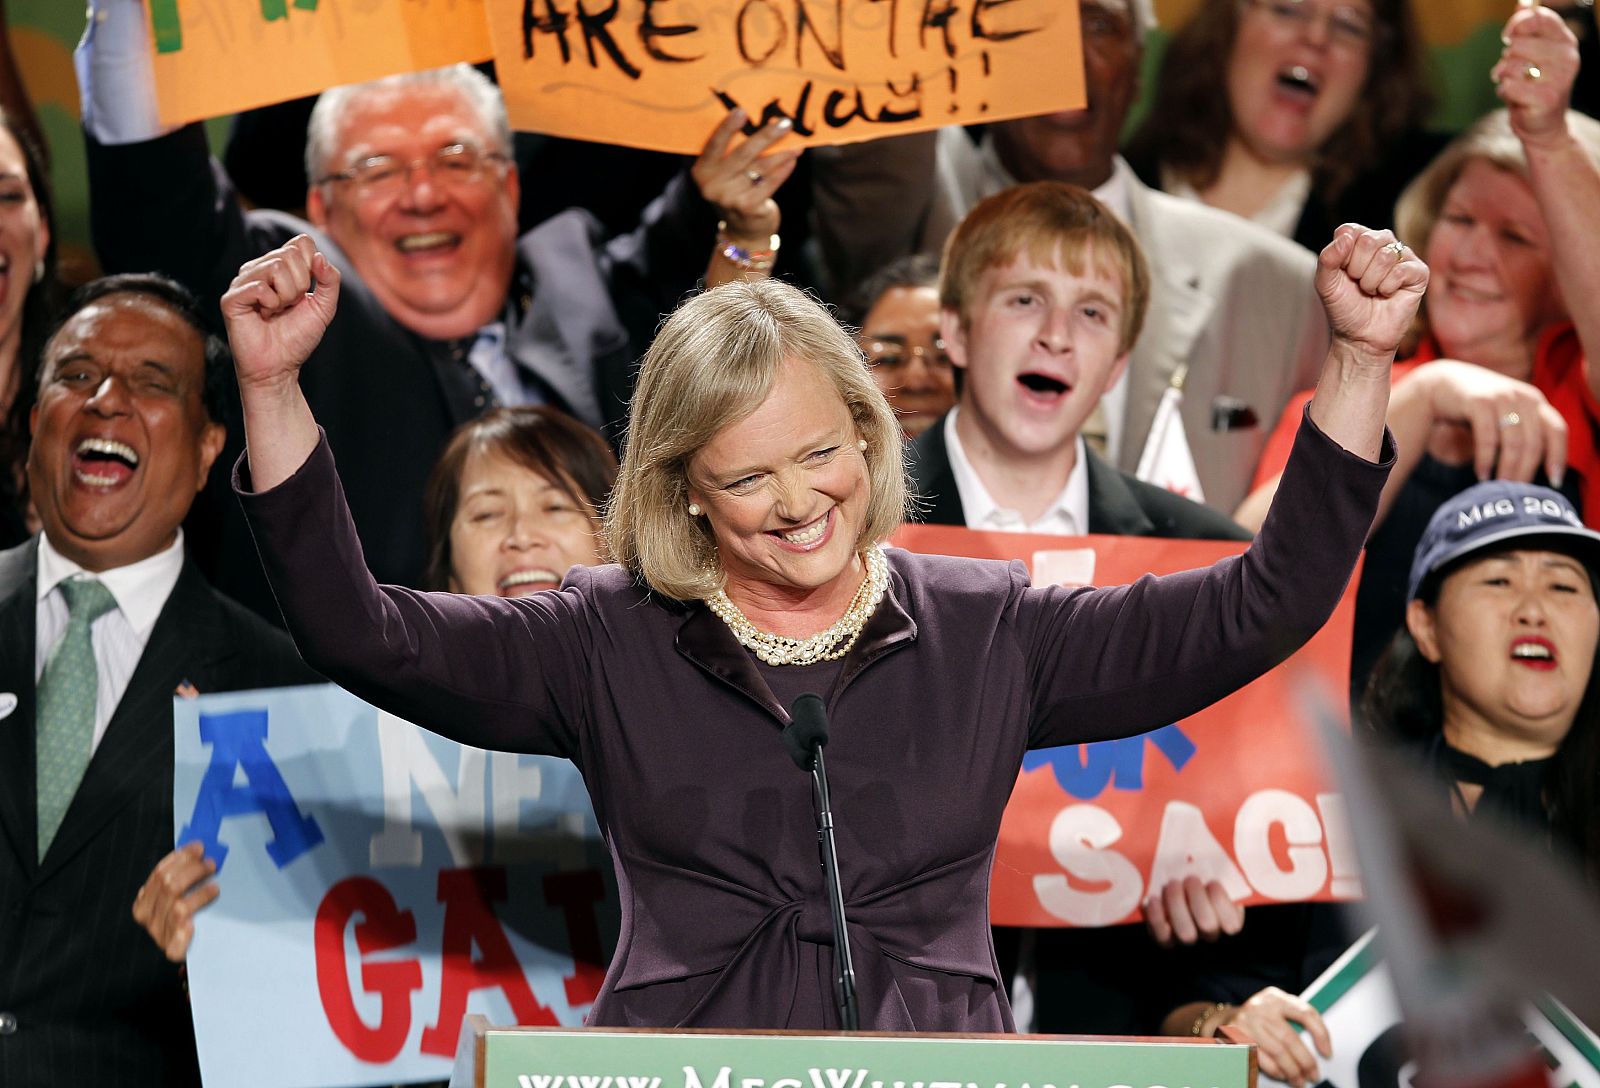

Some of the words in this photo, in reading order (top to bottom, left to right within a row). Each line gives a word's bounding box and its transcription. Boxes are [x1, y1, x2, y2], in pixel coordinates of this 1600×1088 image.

[522, 0, 706, 80] ARE
[736, 0, 846, 71] ON
[177, 709, 325, 875] A
